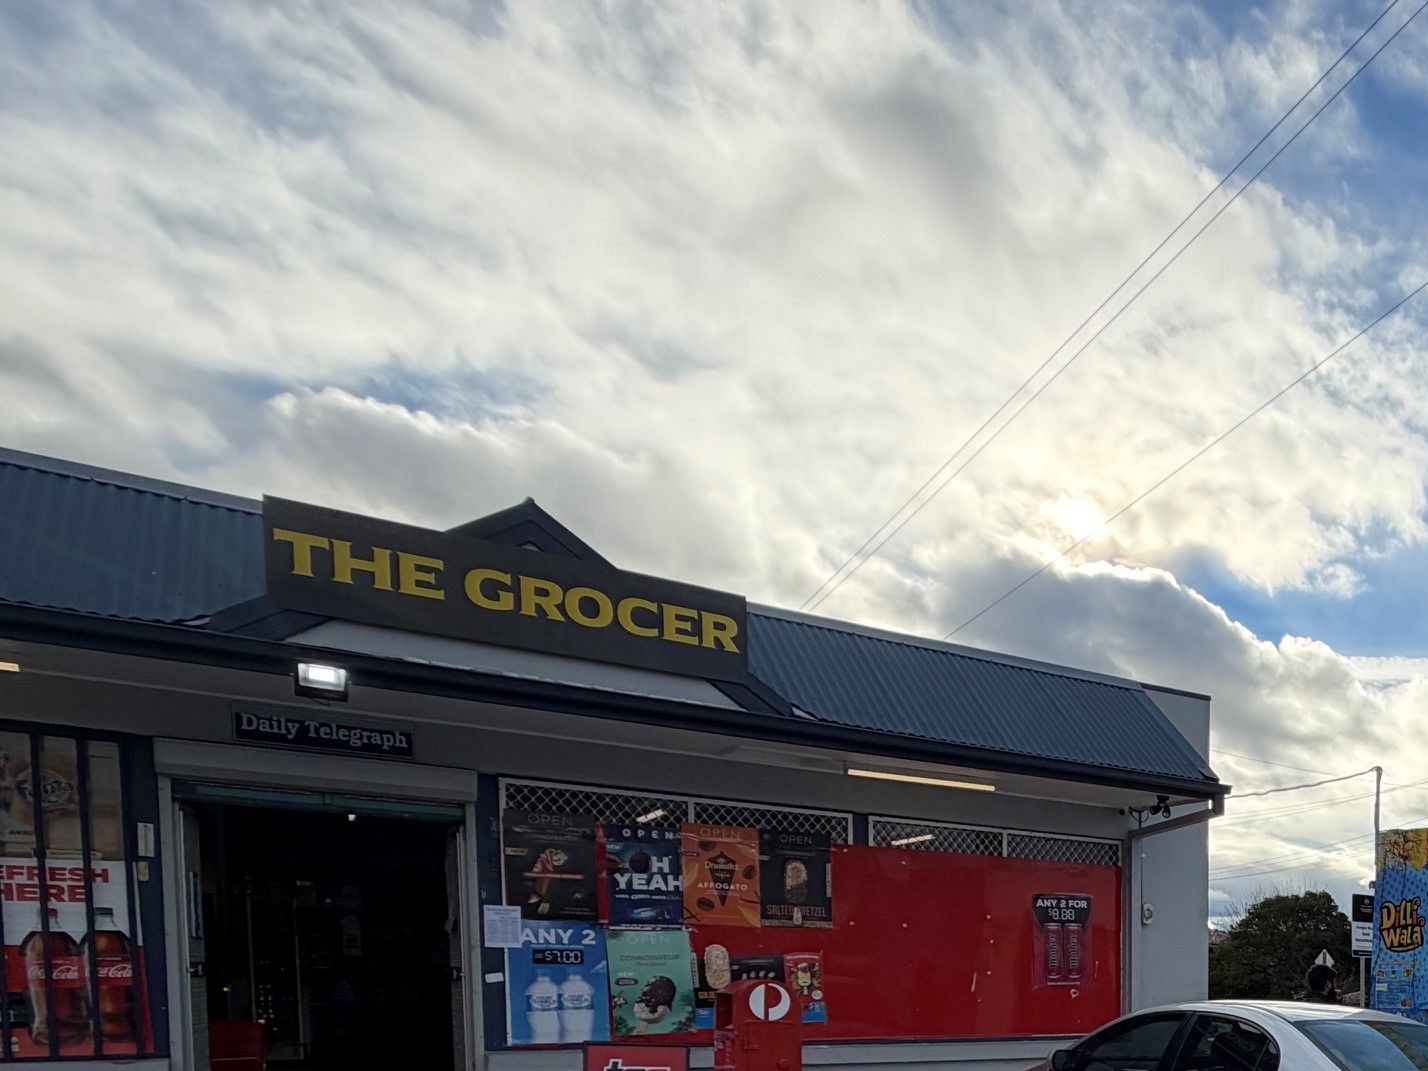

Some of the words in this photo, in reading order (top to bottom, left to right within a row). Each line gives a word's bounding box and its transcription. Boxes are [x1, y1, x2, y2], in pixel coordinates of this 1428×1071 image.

[273, 528, 446, 600] THE
[464, 567, 741, 654] GROCER
[241, 713, 300, 739] Daily
[305, 721, 408, 750] Telegraph
[527, 813, 575, 827] OPEN
[622, 828, 673, 840] OPEN
[700, 827, 741, 840] OPEN
[779, 834, 812, 845] OPEN
[613, 873, 683, 891] YEAH
[697, 882, 748, 892] AFFOGATO
[1036, 899, 1058, 908] ANY
[1060, 900, 1067, 908] 2
[1069, 900, 1088, 909] FOR
[522, 928, 574, 944] ANY
[581, 929, 597, 945] 2
